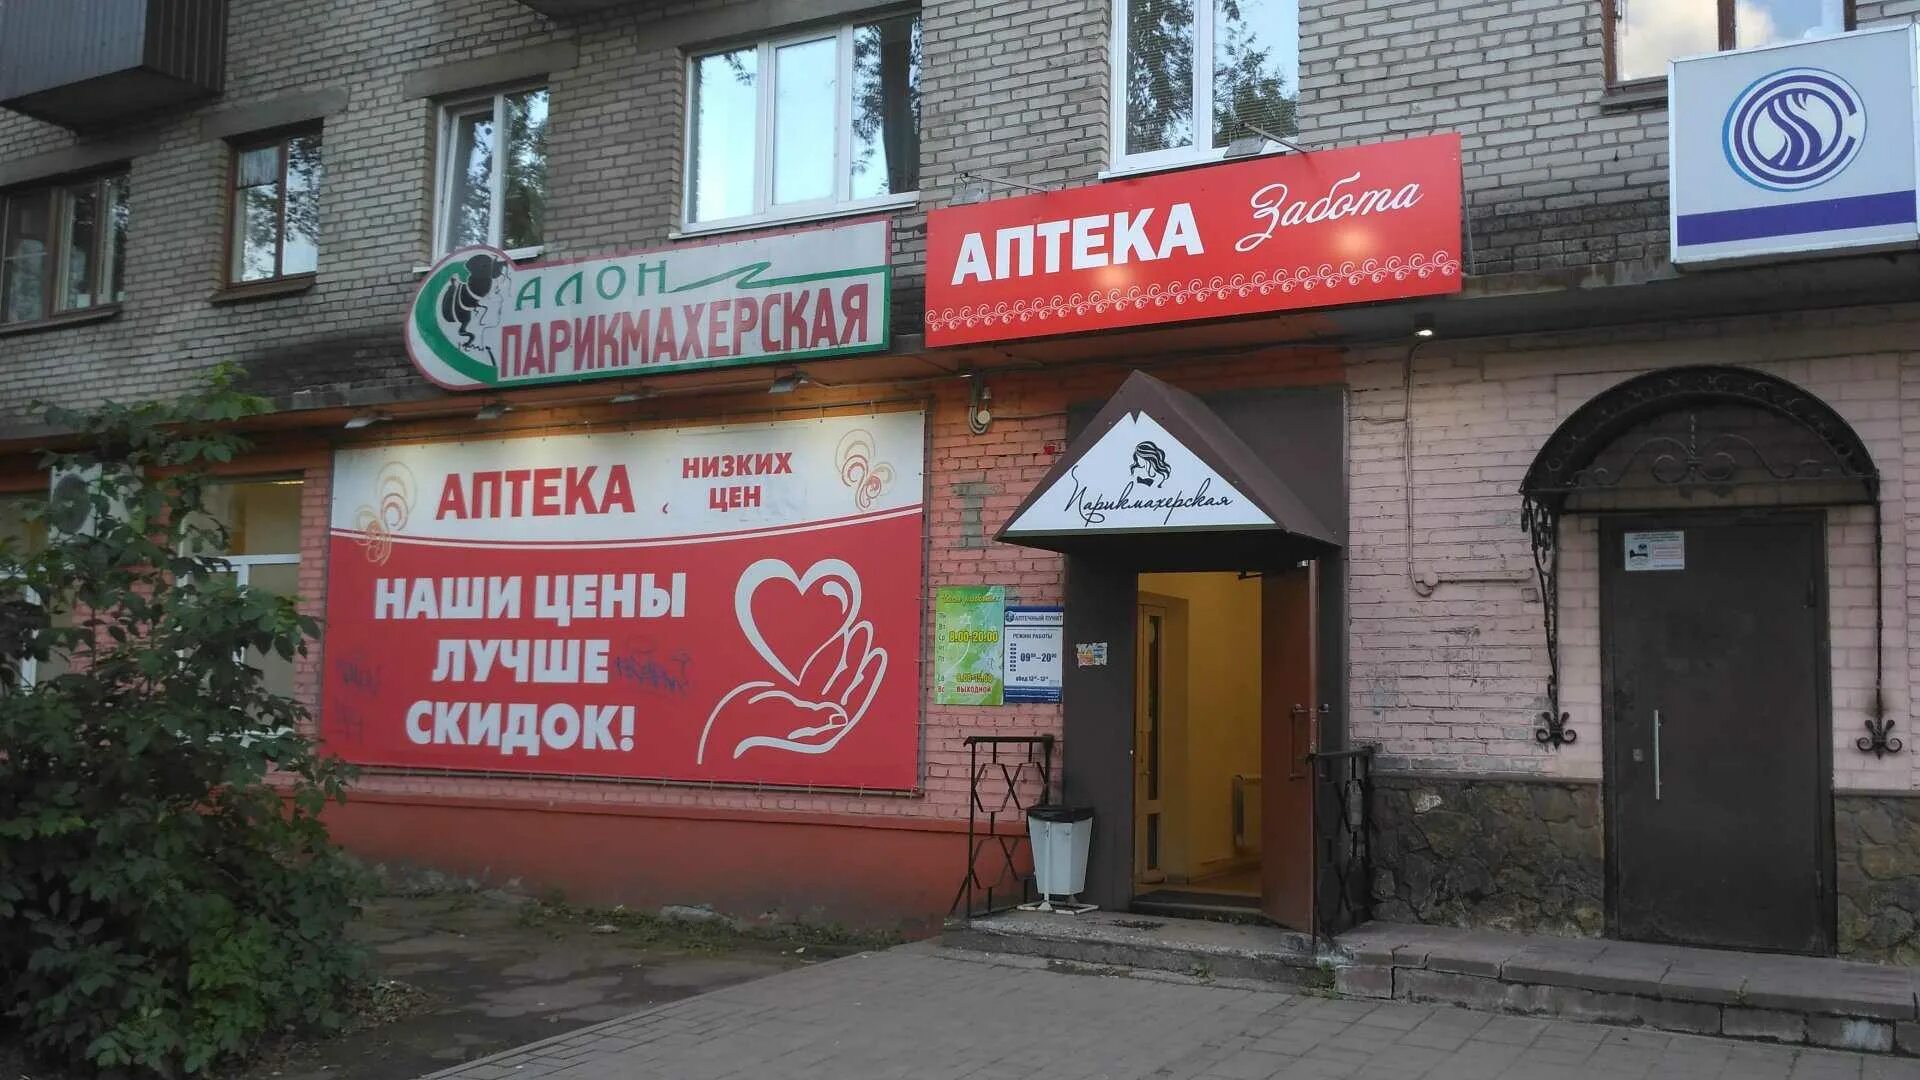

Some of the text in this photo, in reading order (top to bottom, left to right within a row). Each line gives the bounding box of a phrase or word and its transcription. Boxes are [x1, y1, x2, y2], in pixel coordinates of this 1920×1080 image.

[951, 171, 1425, 286] АПТЕКА Забота
[501, 283, 869, 378] ПАРИКМАХЕРСКАЯ
[435, 464, 636, 521] АПТЕКА
[682, 452, 793, 479] НИЗКИХ
[709, 485, 762, 512] ЦЕН
[1064, 465, 1233, 527] Парикмахерская
[375, 572, 687, 626] НАШИ ЦЕНЫ
[432, 639, 610, 684] ЛУЧШЕ
[405, 700, 636, 756] СКИДОК!
